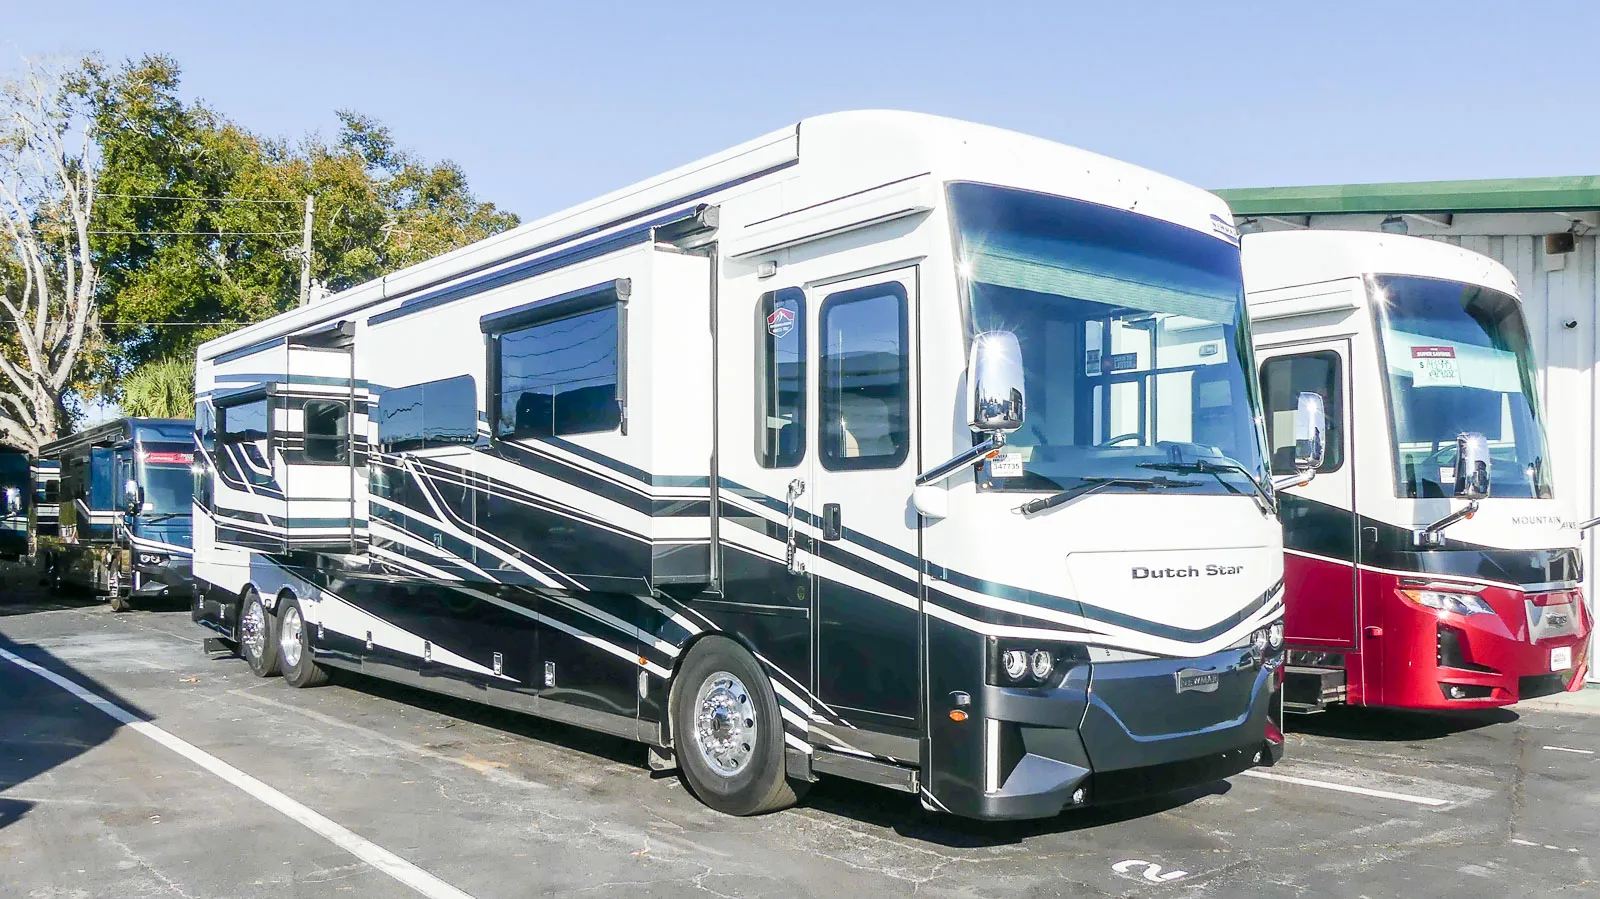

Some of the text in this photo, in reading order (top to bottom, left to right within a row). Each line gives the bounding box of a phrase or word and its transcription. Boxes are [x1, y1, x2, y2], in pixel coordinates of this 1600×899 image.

[1512, 516, 1561, 525] MOUNTAIN
[1131, 564, 1244, 579] Dutch Star
